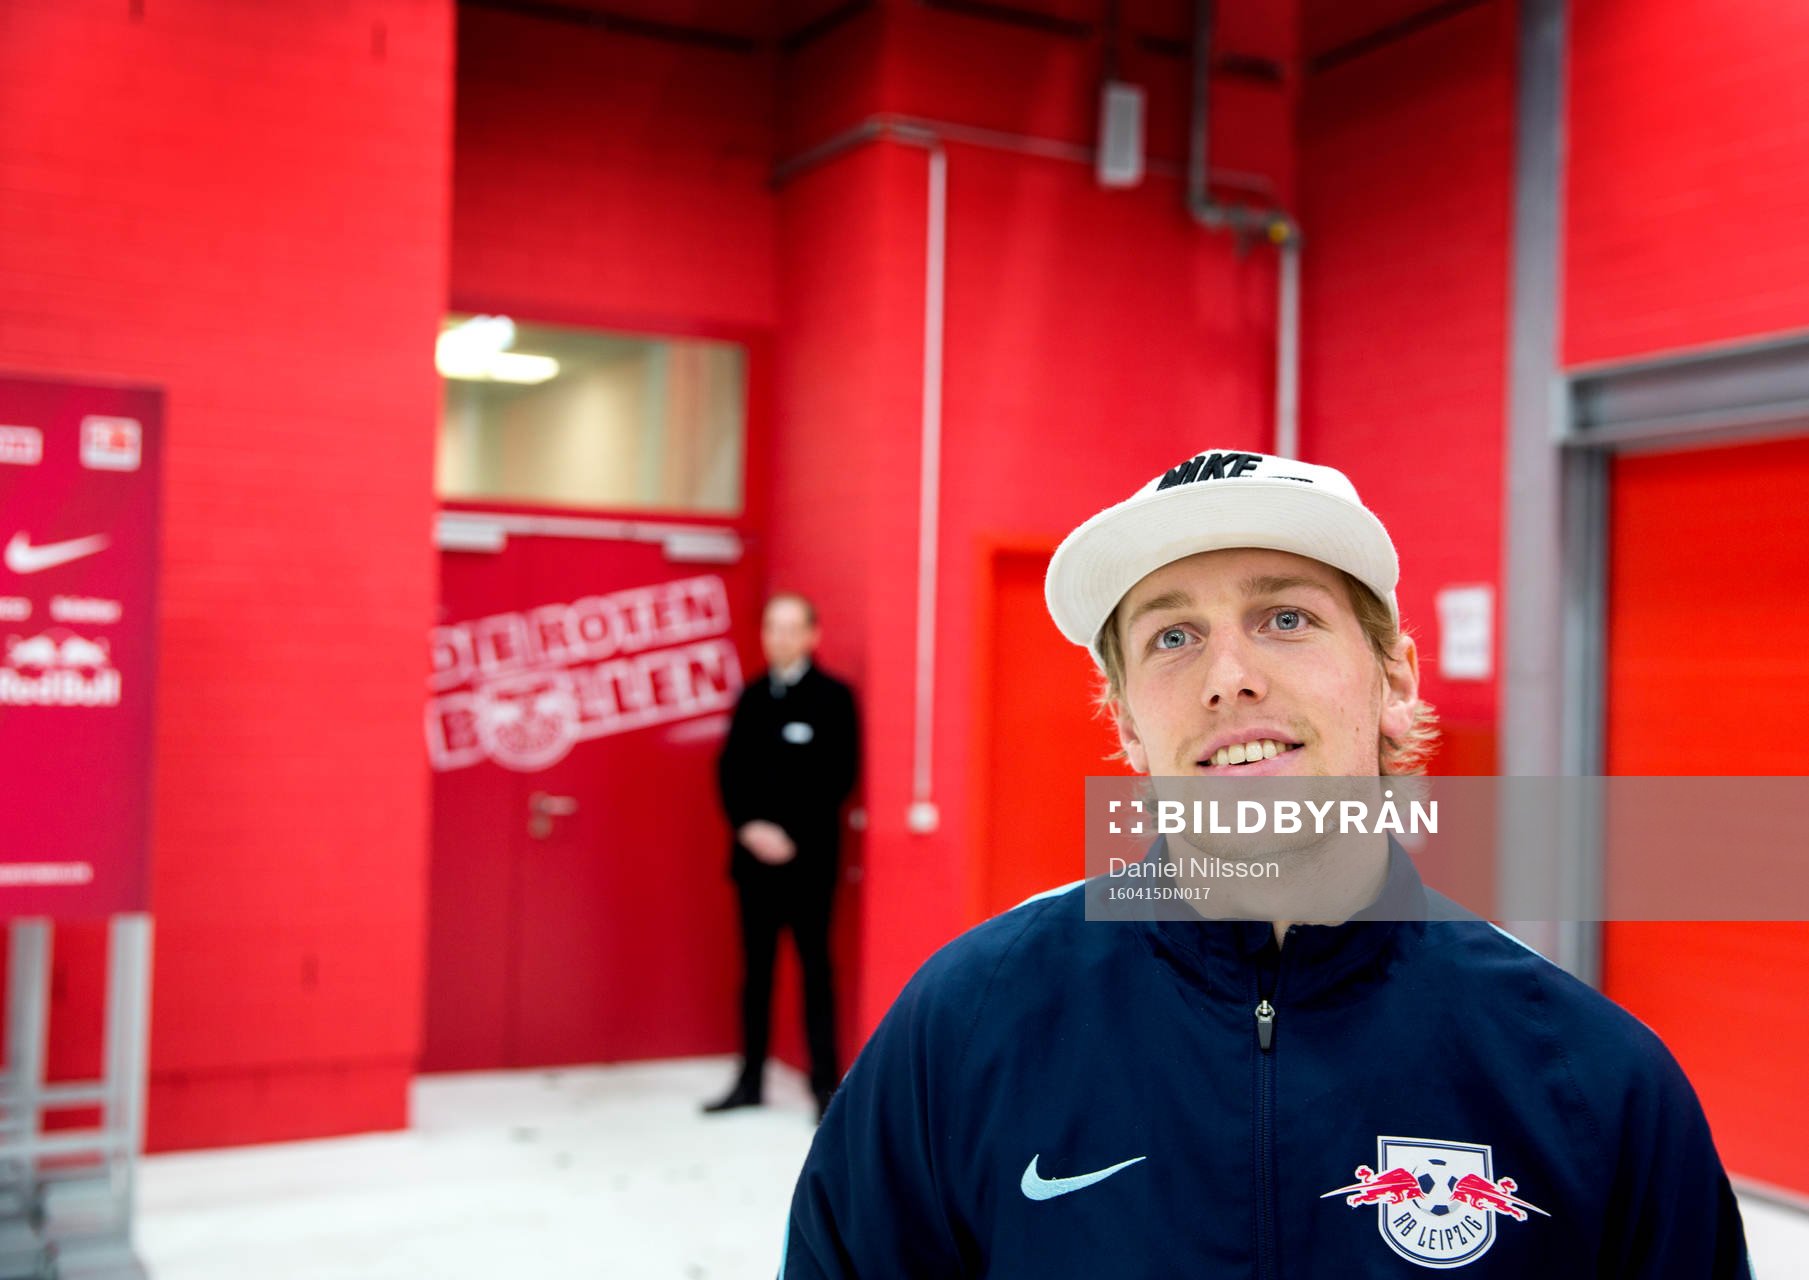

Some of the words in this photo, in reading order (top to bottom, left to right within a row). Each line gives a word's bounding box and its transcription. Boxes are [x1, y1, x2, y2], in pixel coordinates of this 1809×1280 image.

[1157, 452, 1264, 491] NIKE
[438, 655, 730, 753] BLLEN
[1418, 1215, 1483, 1251] LEIPZIG
